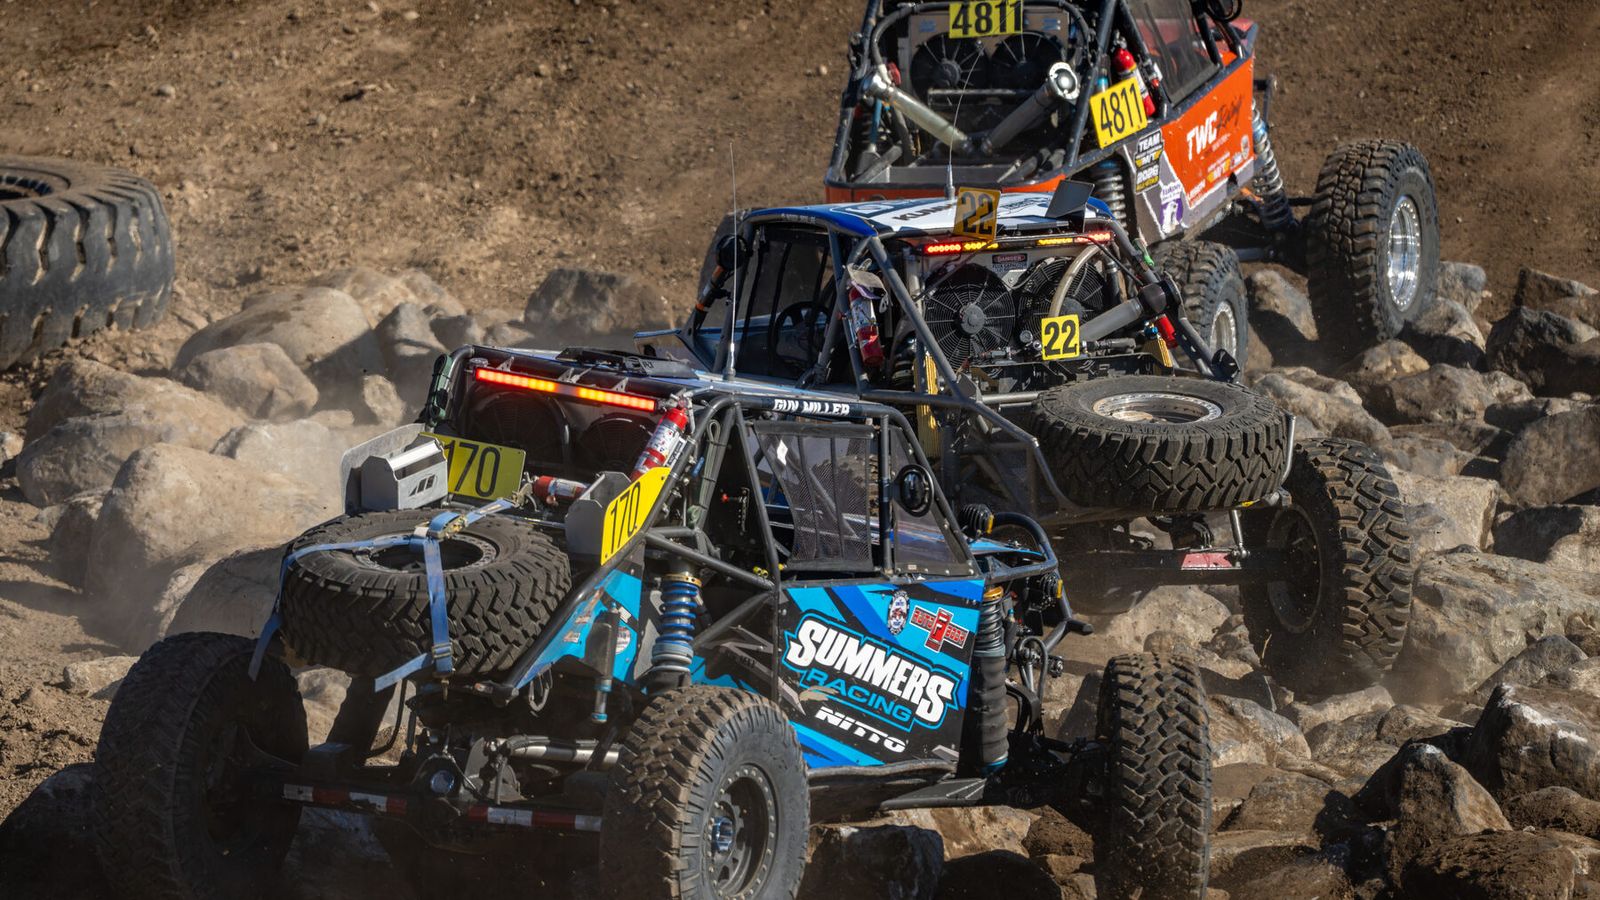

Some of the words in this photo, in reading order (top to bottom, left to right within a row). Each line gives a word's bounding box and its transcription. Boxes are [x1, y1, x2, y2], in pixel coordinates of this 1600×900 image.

[951, 0, 1023, 35] 4811
[1099, 83, 1143, 138] 4811
[1138, 132, 1161, 153] TEAM
[1186, 110, 1218, 161] TWC
[960, 190, 995, 235] 22
[1044, 319, 1077, 356] 22
[801, 400, 850, 416] MILLER
[442, 439, 501, 498] 170
[610, 481, 641, 555] 170
[786, 619, 955, 723] SUMMERS
[806, 668, 913, 723] RACING
[814, 706, 907, 753] NITTO
